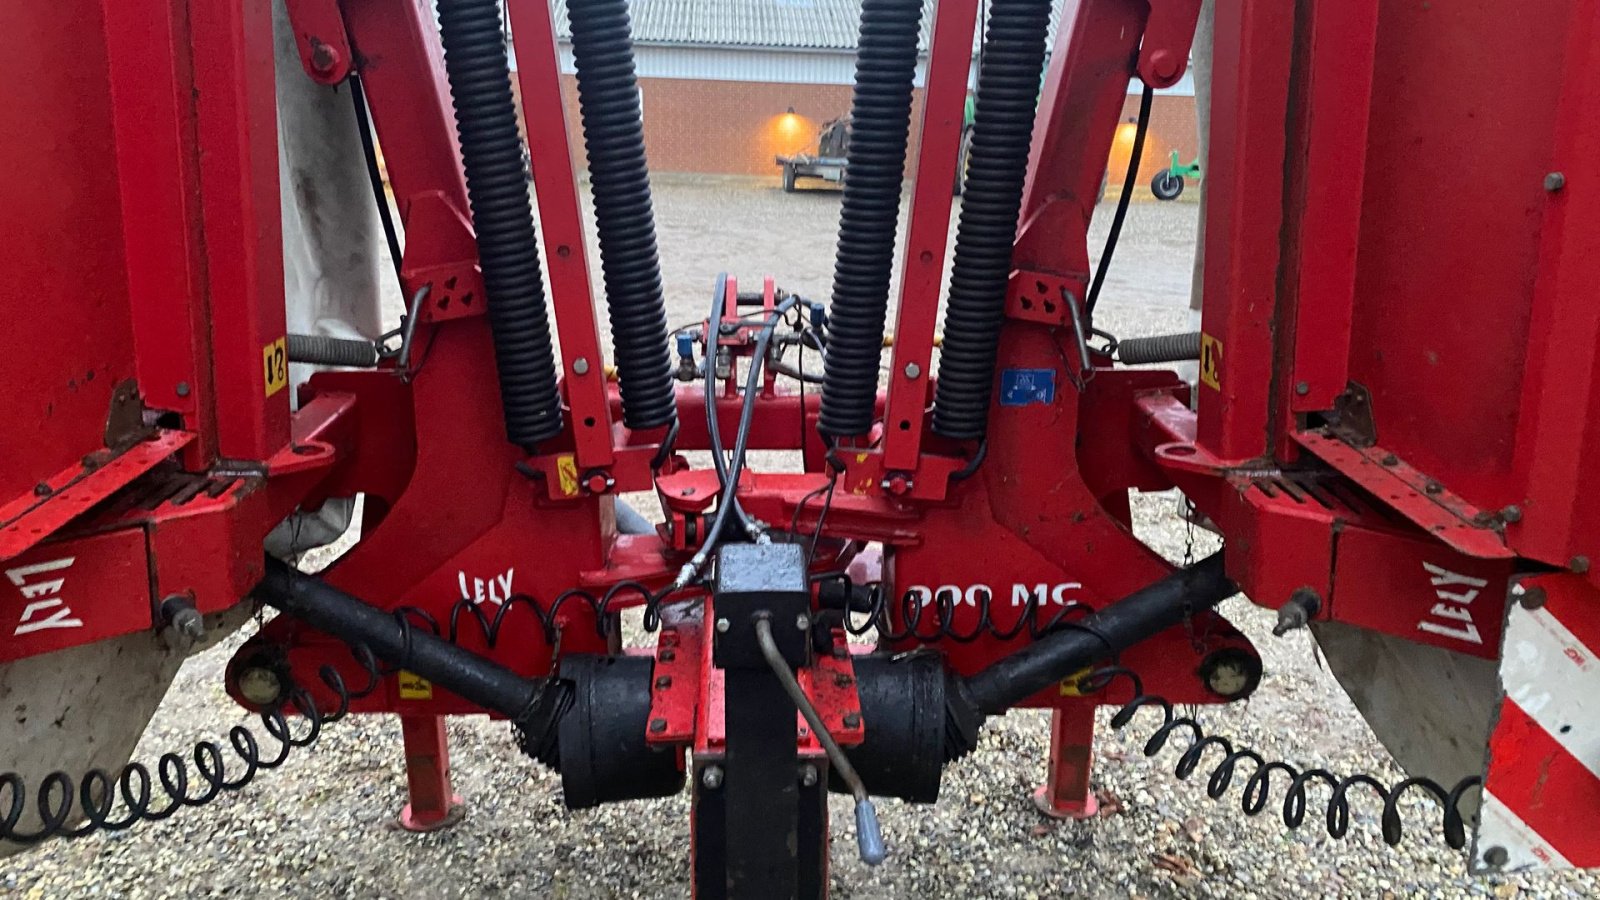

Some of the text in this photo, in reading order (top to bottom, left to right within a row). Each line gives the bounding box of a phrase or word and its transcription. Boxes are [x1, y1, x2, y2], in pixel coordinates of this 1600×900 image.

[4, 555, 83, 636] LELY
[458, 567, 513, 612] LELY
[1011, 582, 1082, 607] MC
[1416, 560, 1488, 645] LELY
